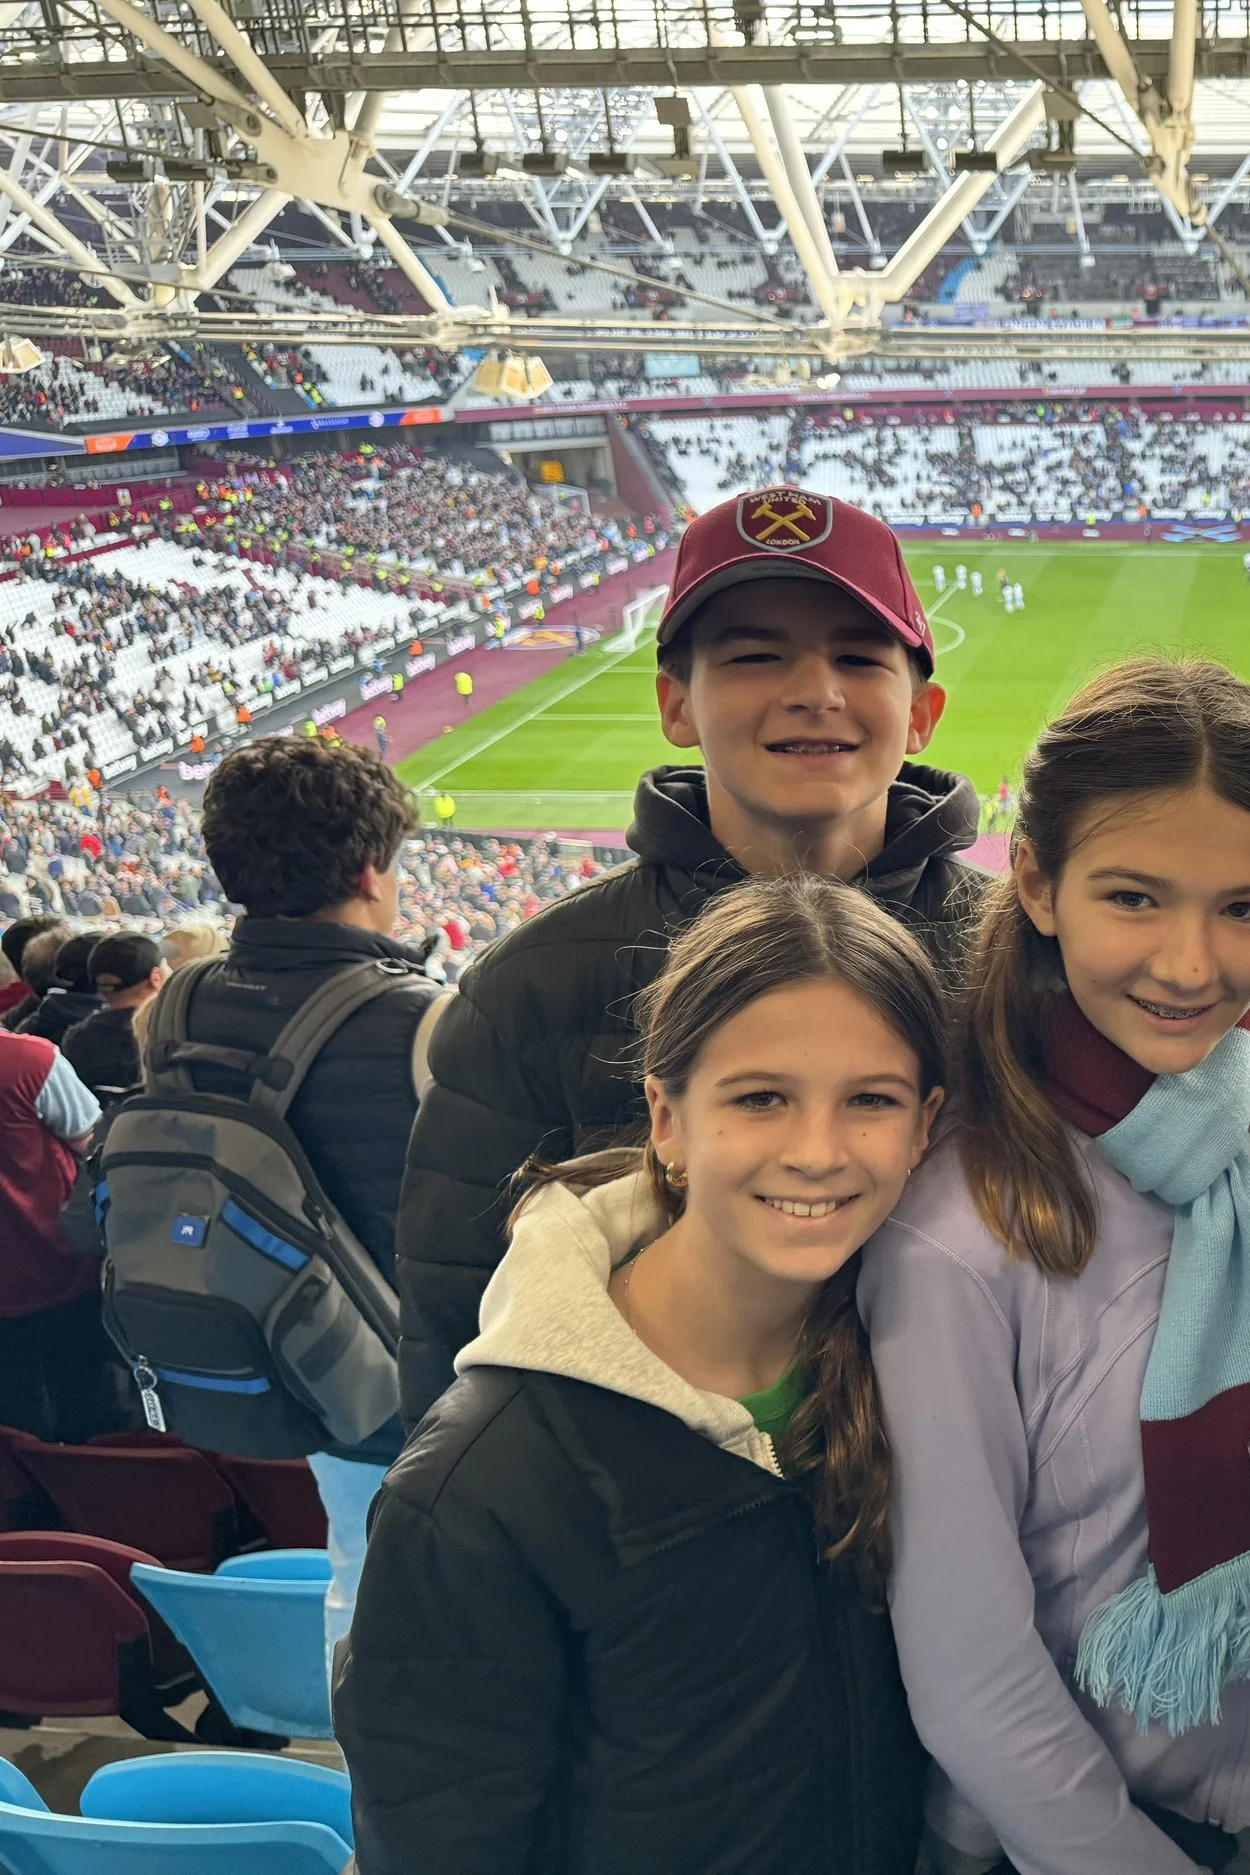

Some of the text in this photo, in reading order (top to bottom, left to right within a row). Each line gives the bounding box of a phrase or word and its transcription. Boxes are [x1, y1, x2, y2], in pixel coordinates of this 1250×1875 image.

[750, 491, 822, 506] WEST HAM
[762, 496, 807, 505] UNITED
[765, 538, 801, 546] LONDON
